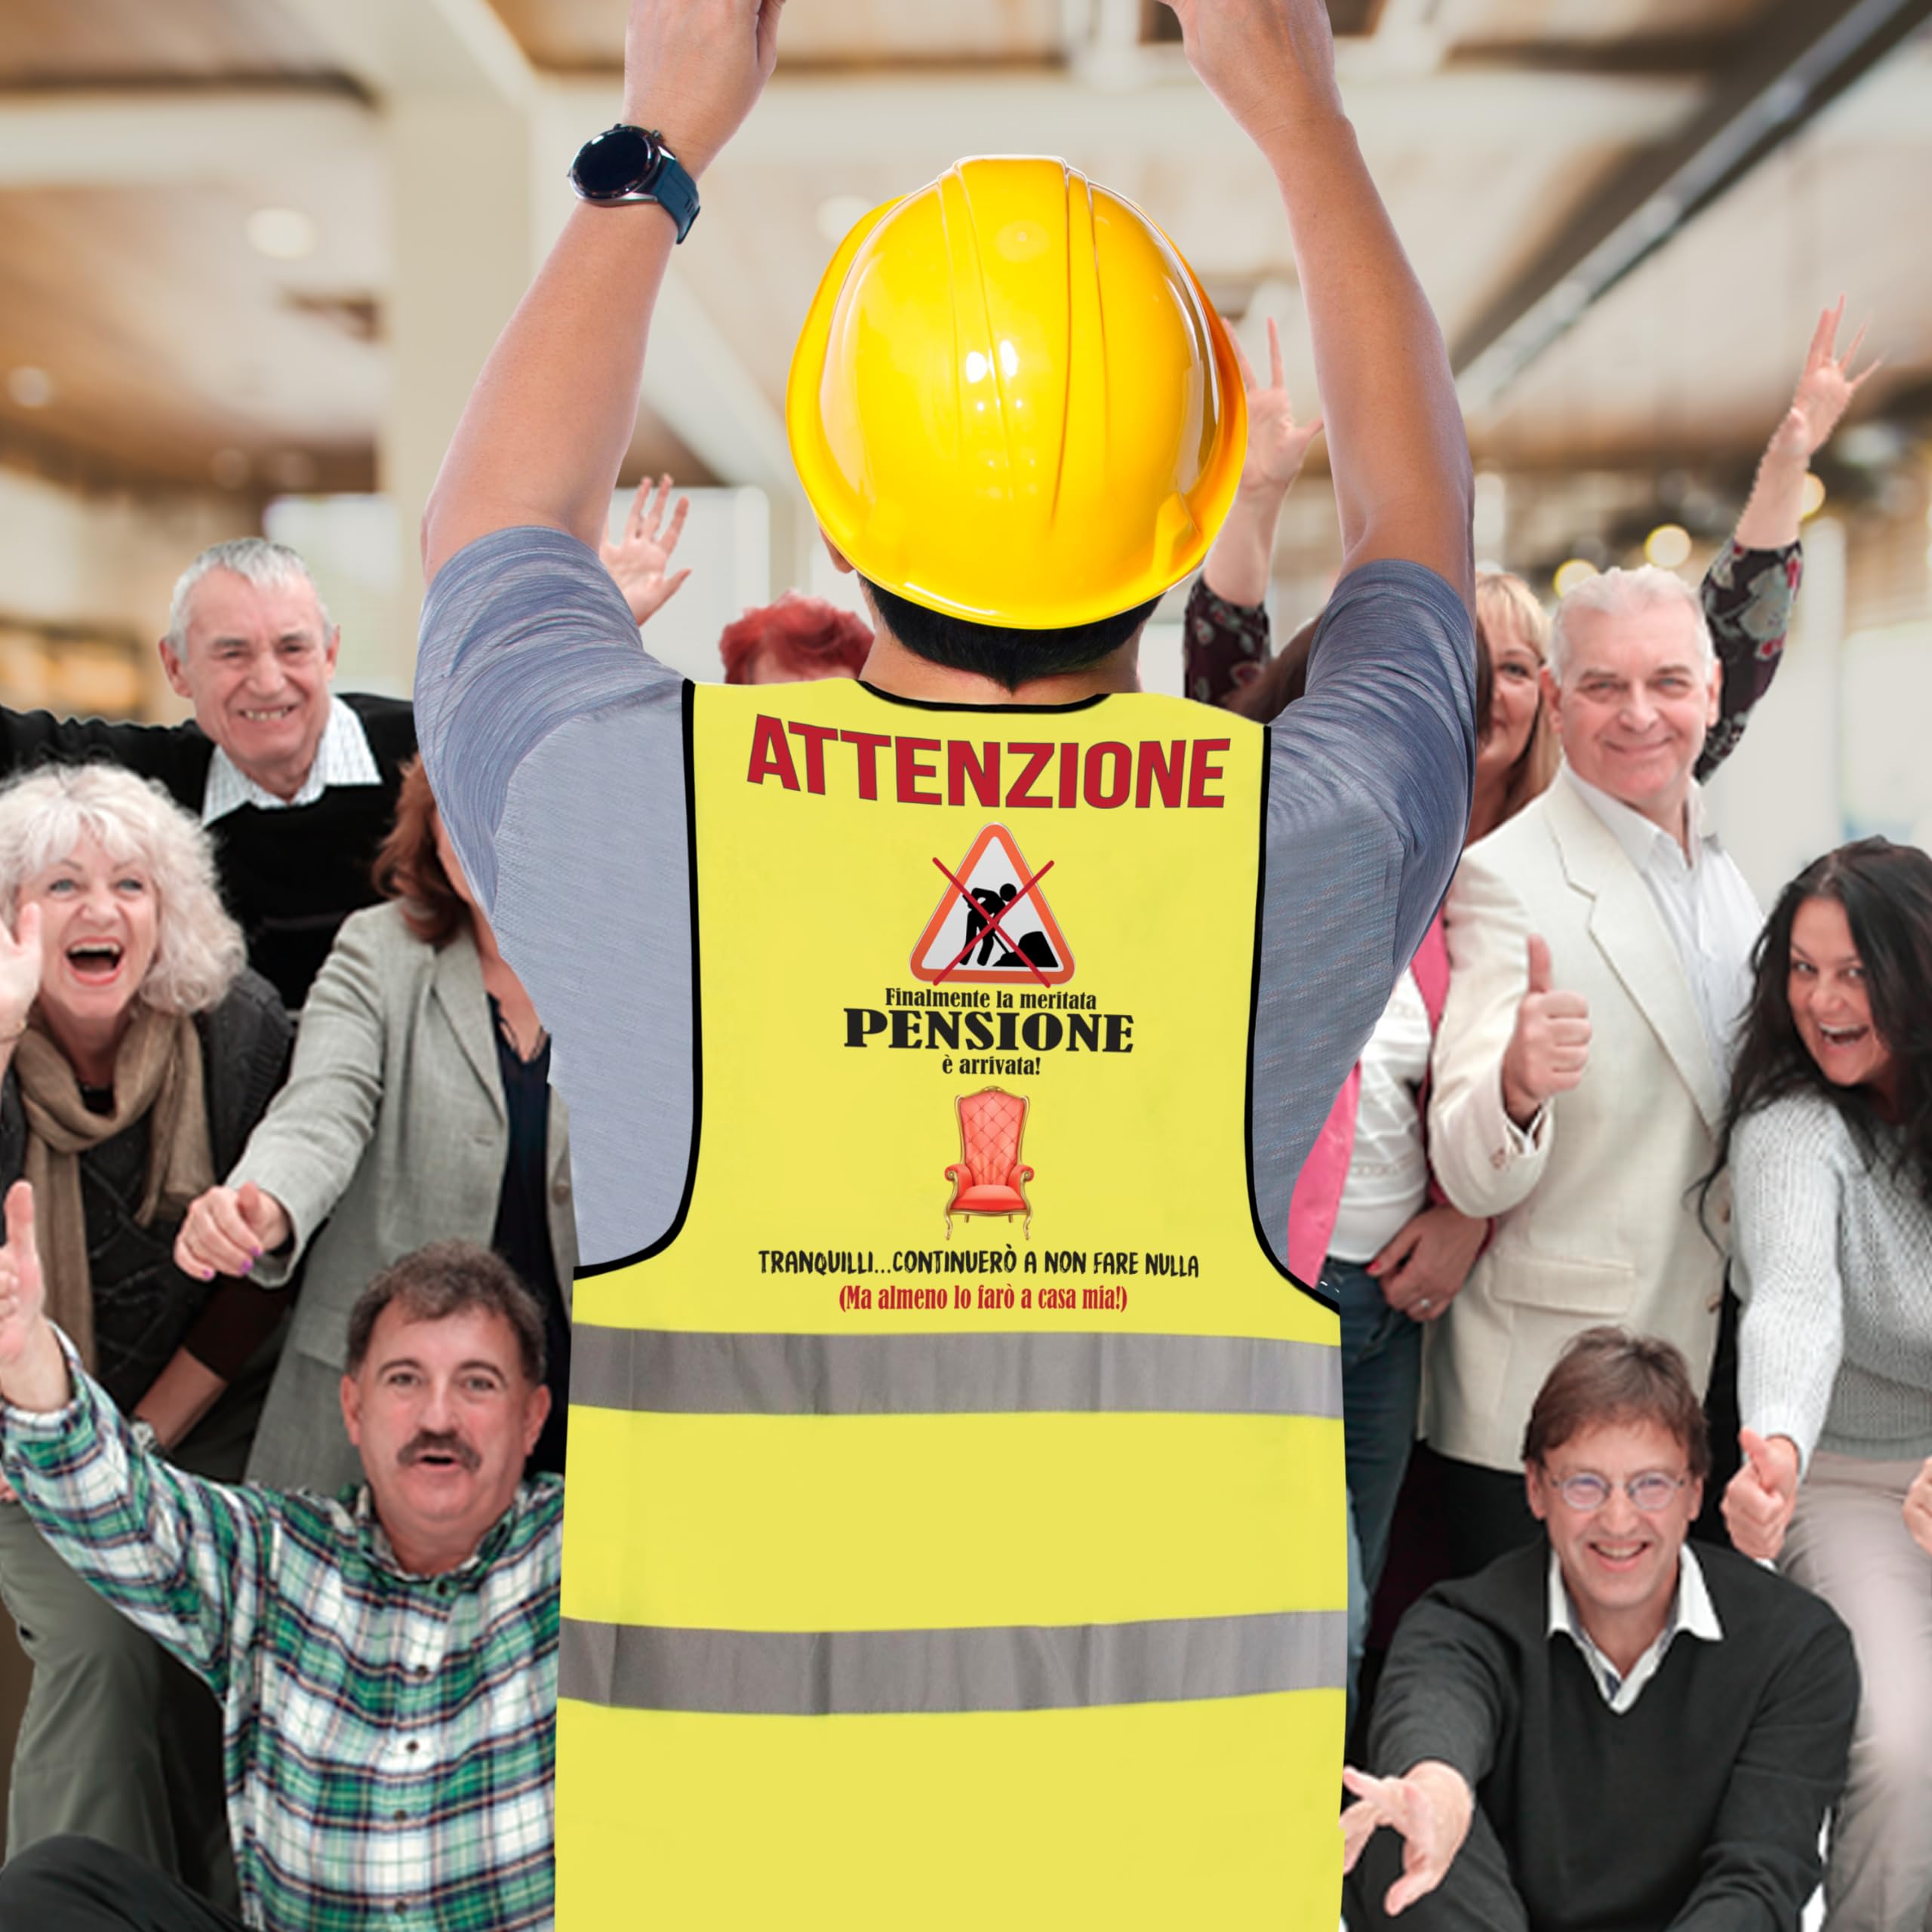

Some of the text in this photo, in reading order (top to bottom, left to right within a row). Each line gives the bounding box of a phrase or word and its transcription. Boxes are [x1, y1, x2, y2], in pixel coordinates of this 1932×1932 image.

[746, 713, 1232, 810] ATTENZIONE
[885, 987, 1097, 1011] Finalmente la meritata
[843, 1008, 1134, 1054] PENSIONE
[942, 1054, 1041, 1075] è arrivata!
[1024, 1251, 1037, 1275] A
[1044, 1251, 1087, 1275] NON
[1093, 1251, 1139, 1275] FARE
[1145, 1252, 1199, 1278] NULLA
[838, 1283, 1128, 1312] (Ma almeno lo farò a casa mia!)
